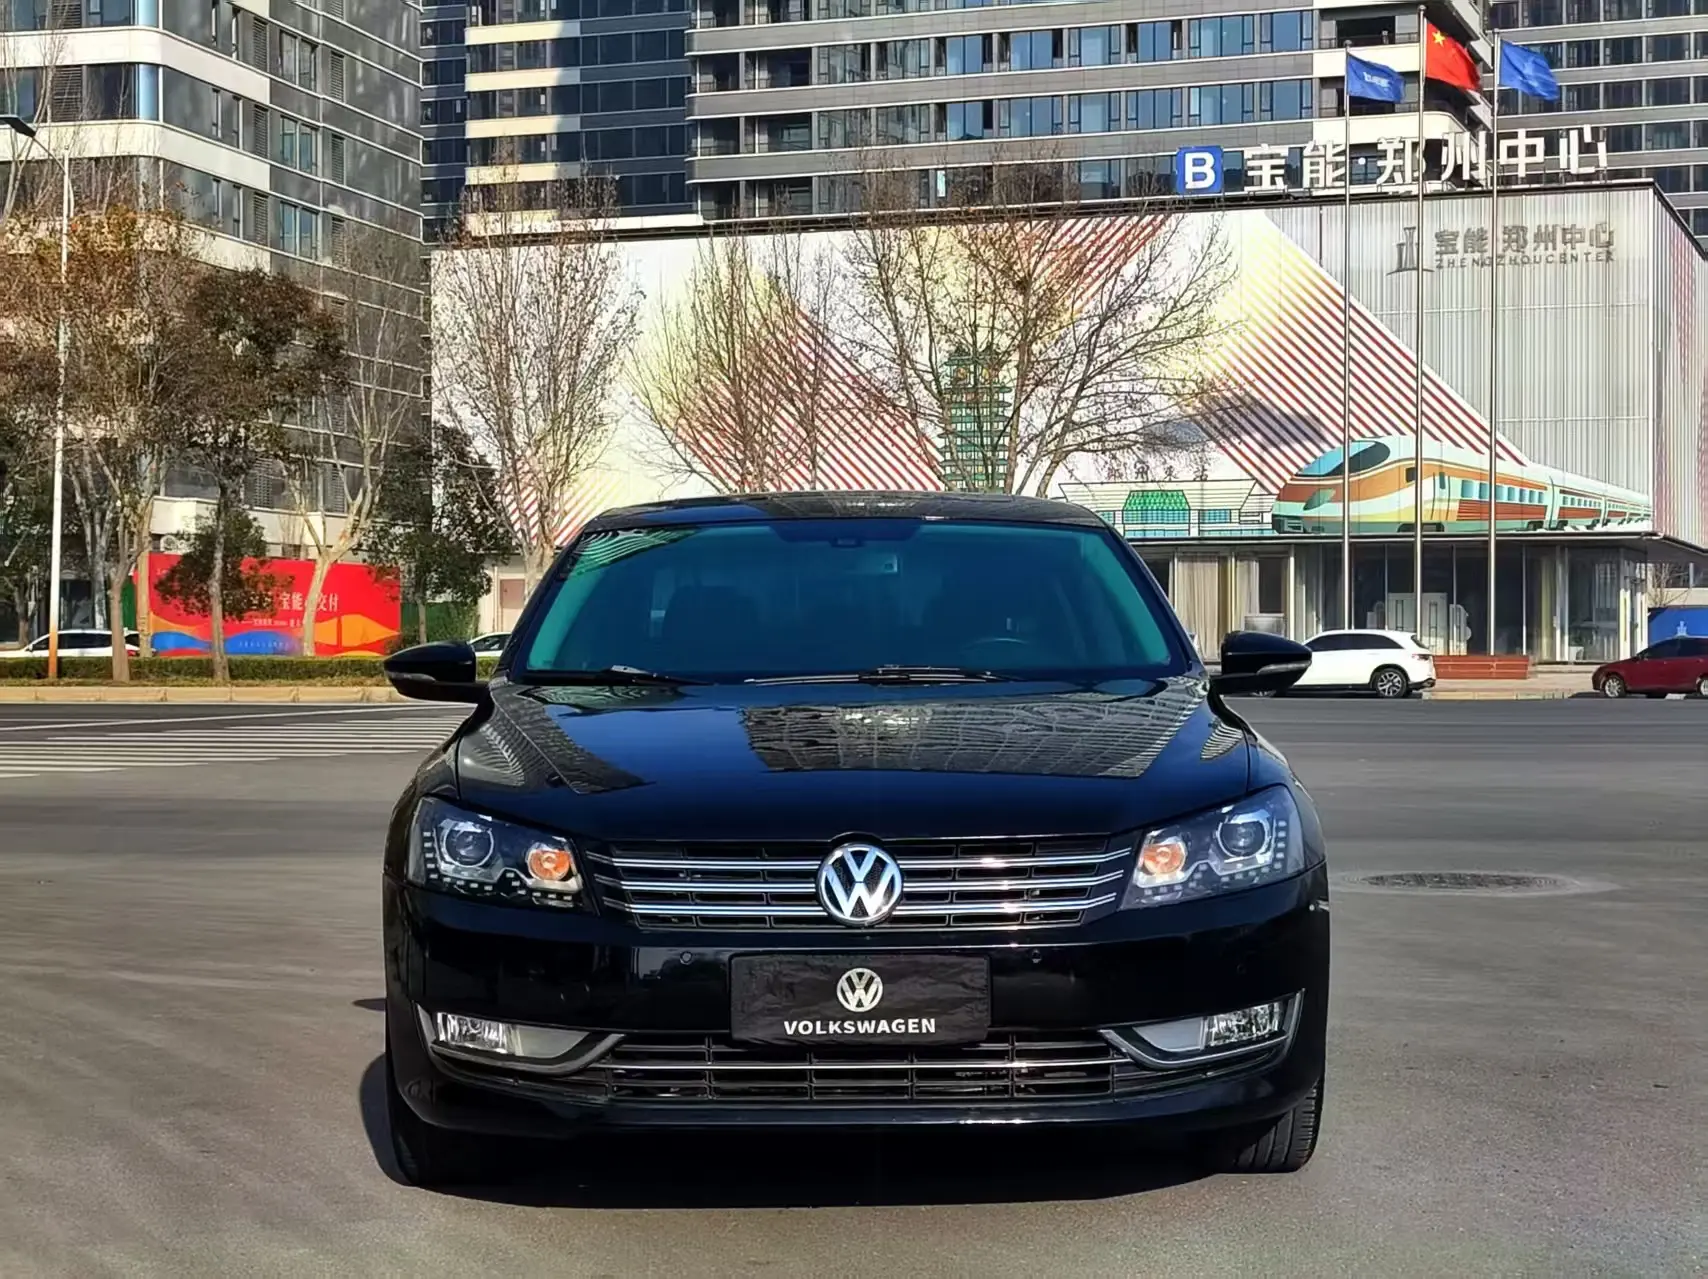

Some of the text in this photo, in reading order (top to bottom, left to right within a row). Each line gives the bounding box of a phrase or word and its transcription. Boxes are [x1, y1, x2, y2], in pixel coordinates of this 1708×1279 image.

[1184, 151, 1216, 190] B
[1434, 222, 1615, 256] 宝能郑州中心
[784, 1018, 936, 1035] VOLKSWAGEN
